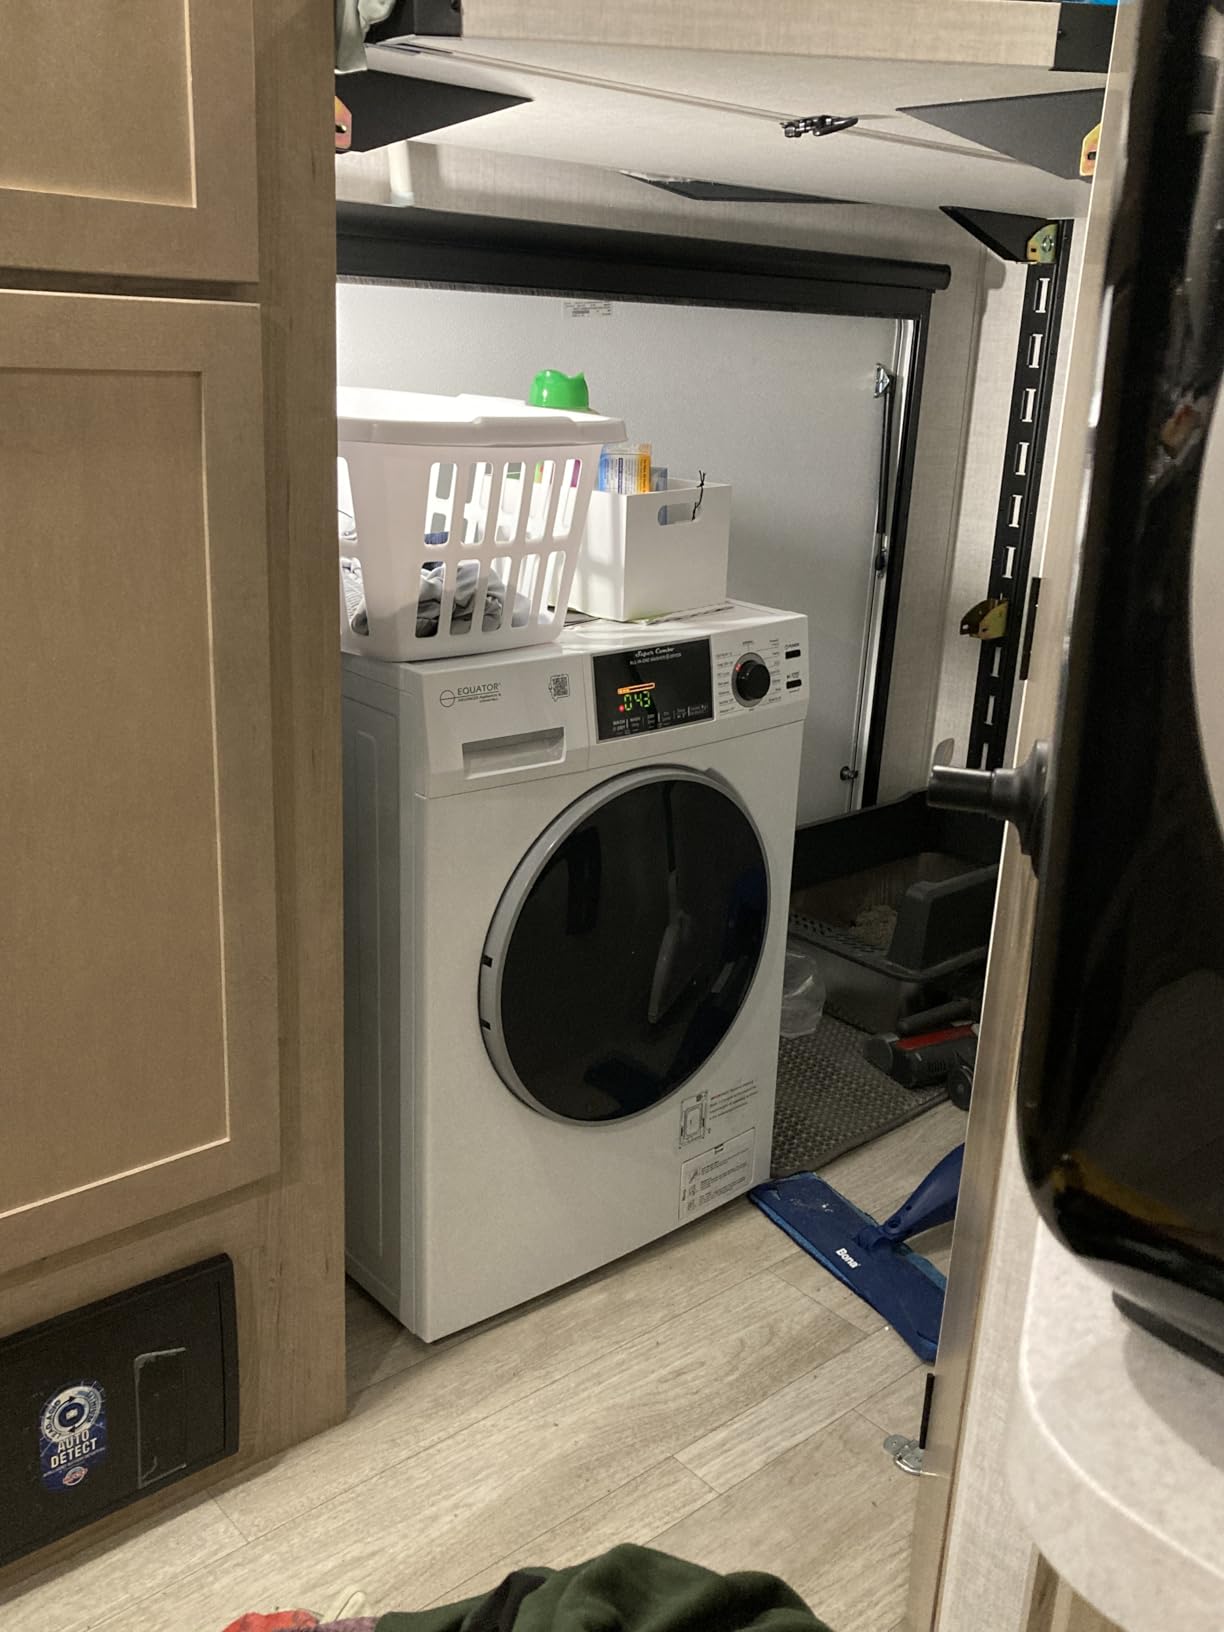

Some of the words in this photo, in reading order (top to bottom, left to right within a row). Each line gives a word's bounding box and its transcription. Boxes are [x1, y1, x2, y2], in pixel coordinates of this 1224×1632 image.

[457, 682, 499, 695] EQUATOR
[835, 1247, 859, 1268] Bona
[57, 1429, 90, 1453] AUTO
[50, 1438, 98, 1469] DETECT
